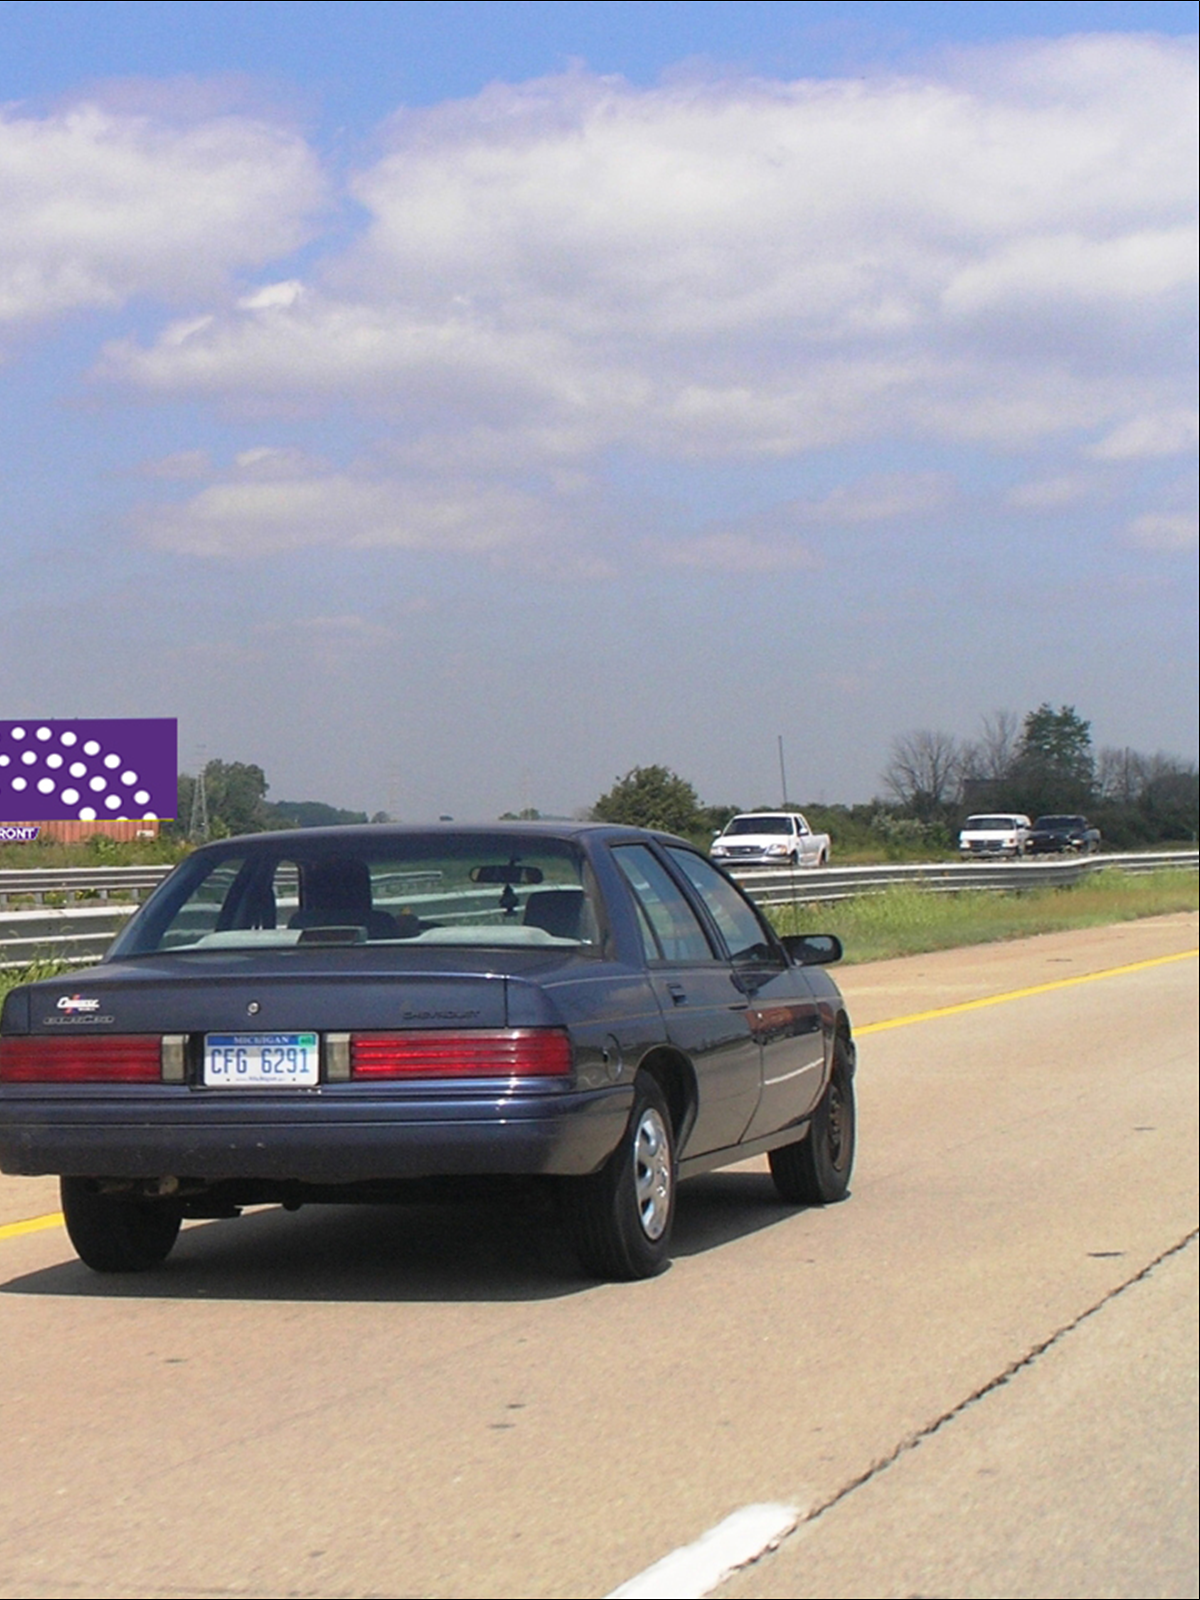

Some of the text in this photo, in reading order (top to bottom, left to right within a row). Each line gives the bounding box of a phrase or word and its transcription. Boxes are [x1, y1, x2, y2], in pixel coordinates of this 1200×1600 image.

[233, 1036, 290, 1044] MICHIGAN
[211, 1048, 309, 1074] CFG 6291
